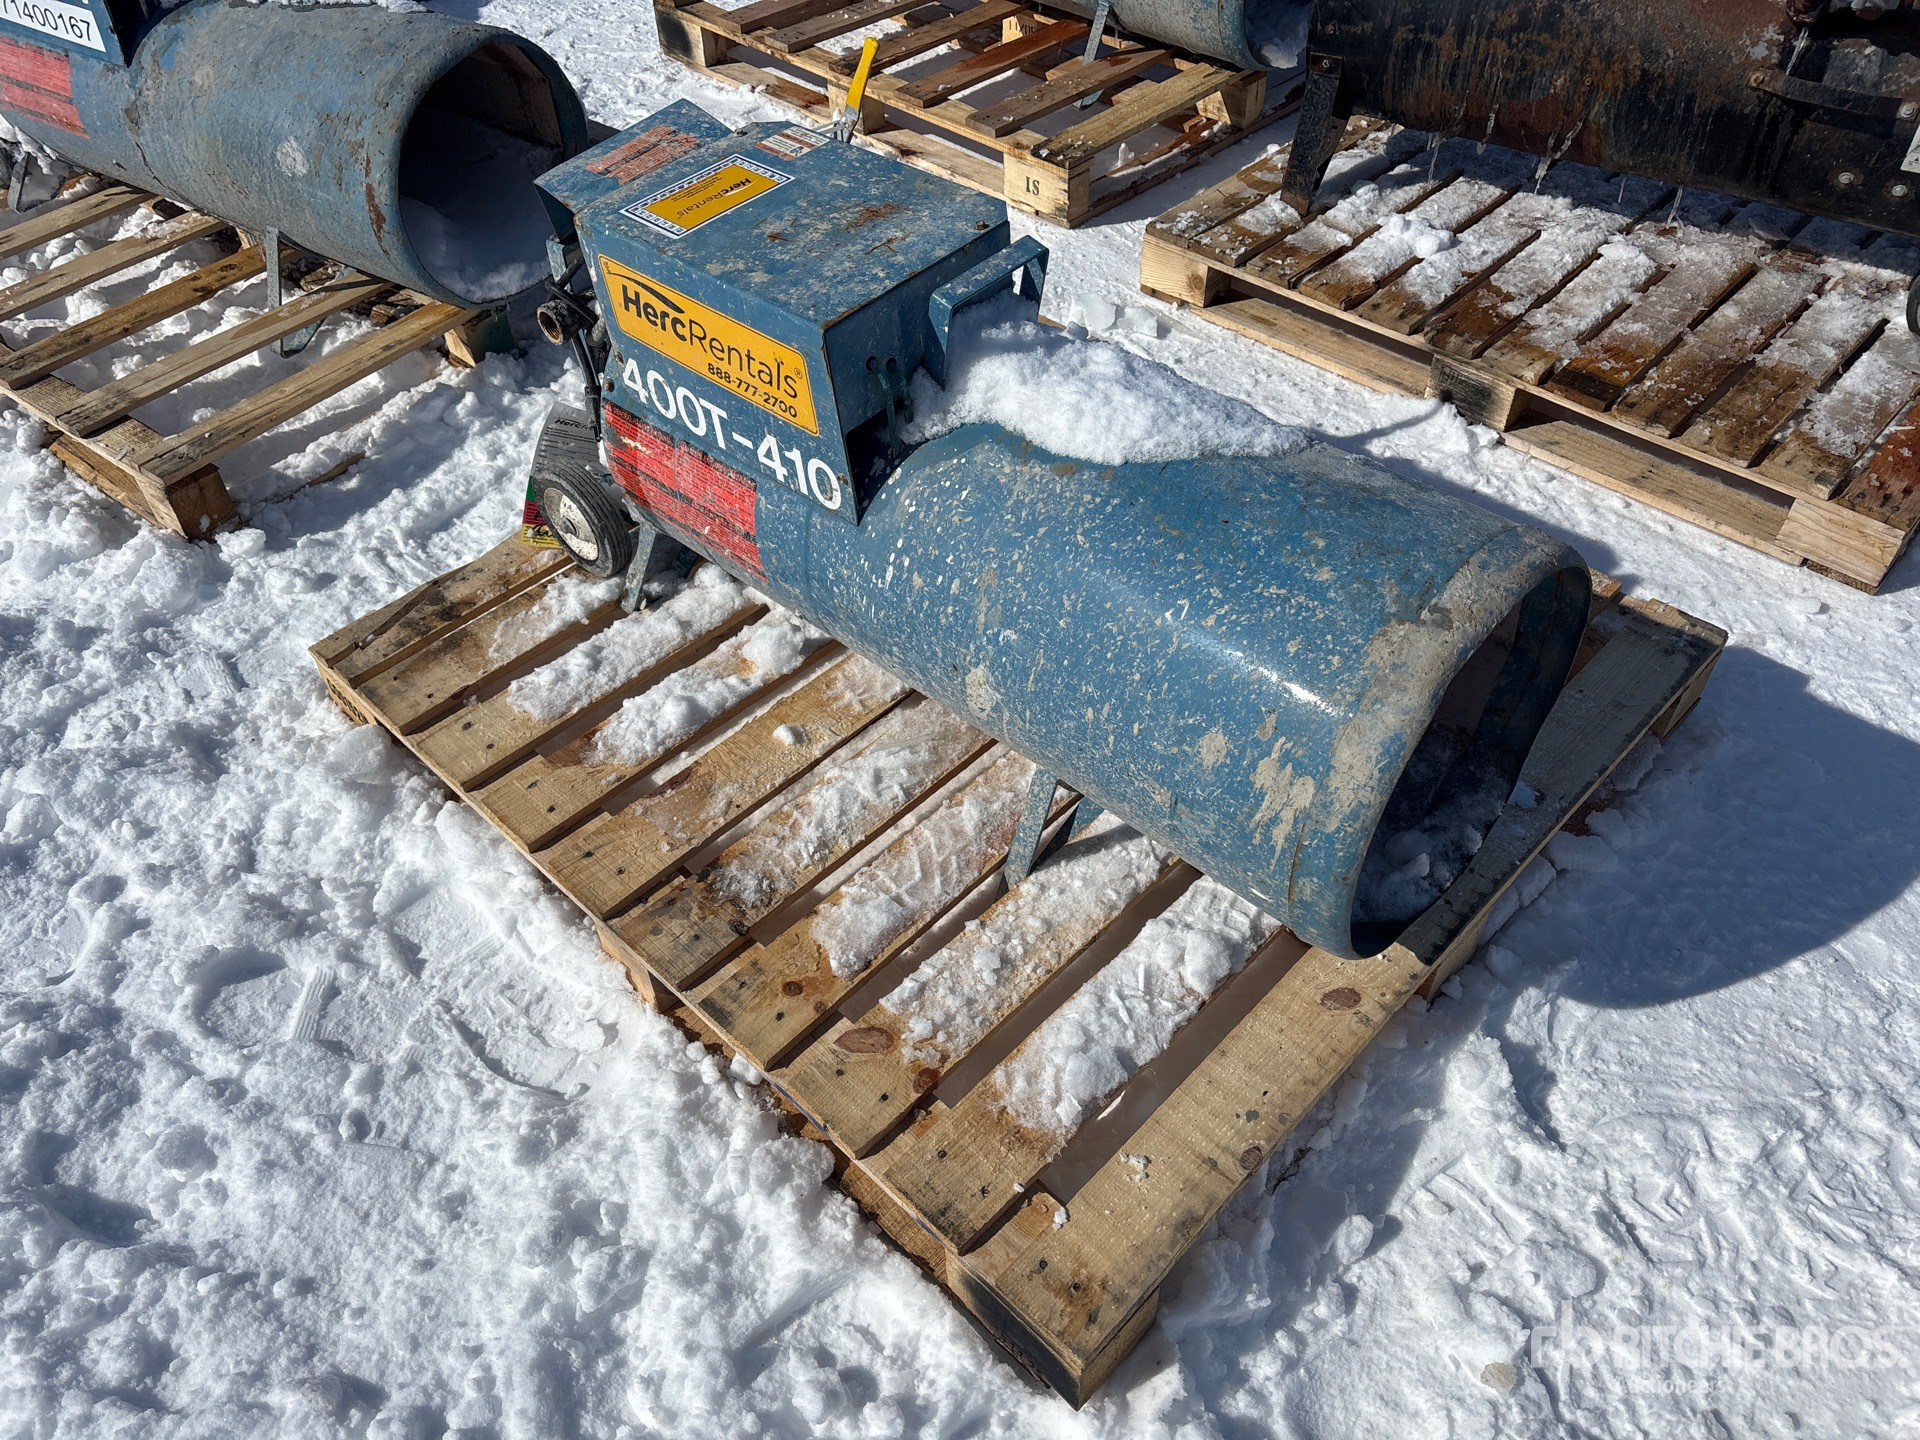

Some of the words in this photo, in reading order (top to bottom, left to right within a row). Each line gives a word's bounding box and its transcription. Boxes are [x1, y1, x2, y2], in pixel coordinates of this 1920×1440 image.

[676, 177, 752, 217] HercRentals
[621, 283, 798, 399] HercRentals
[622, 357, 842, 510] 400T-410
[707, 362, 798, 419] 888-777-2700
